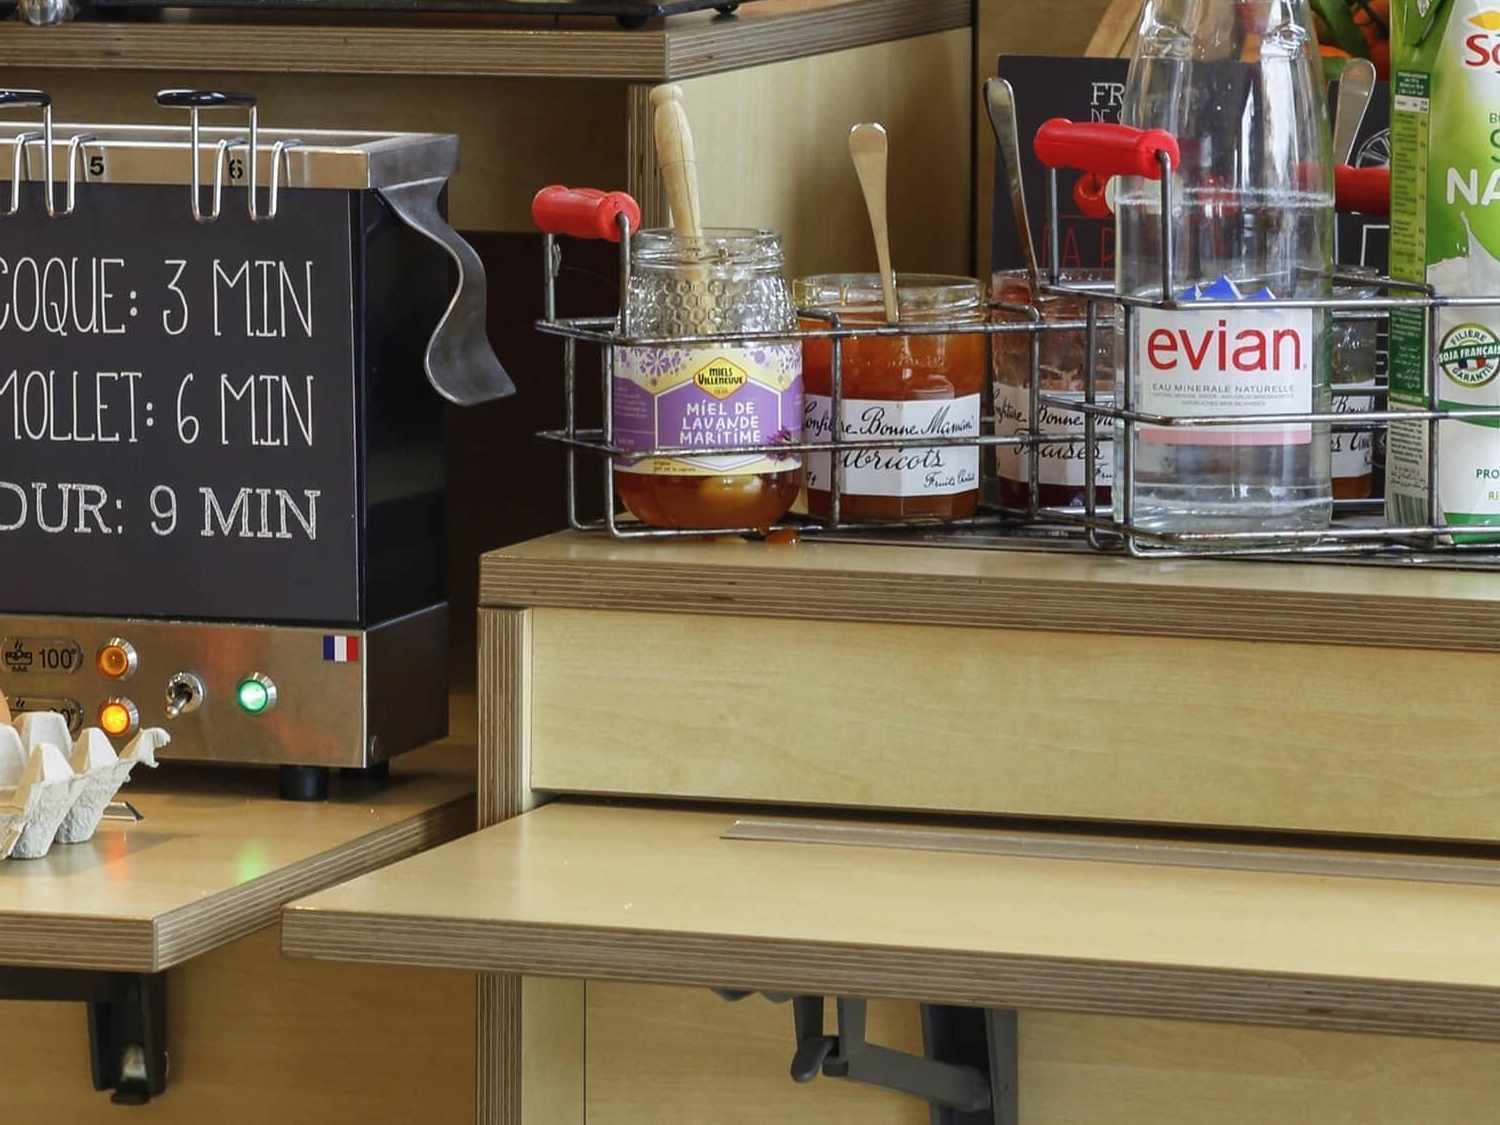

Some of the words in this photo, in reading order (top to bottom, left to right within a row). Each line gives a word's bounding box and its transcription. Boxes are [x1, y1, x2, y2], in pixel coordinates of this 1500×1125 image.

[90, 156, 105, 175] 5
[229, 159, 244, 180] 6
[163, 260, 189, 335] 3
[212, 259, 314, 338] MIN
[1147, 320, 1301, 371] evian
[1152, 383, 1171, 392] EAU
[1236, 385, 1295, 393] NATURELLE
[176, 373, 200, 444] 6
[220, 373, 314, 447] MIN
[682, 416, 760, 431] LAVANDE
[735, 402, 756, 415] DE
[859, 406, 918, 436] Bonne
[149, 485, 178, 536] 9
[199, 487, 321, 540] MIN
